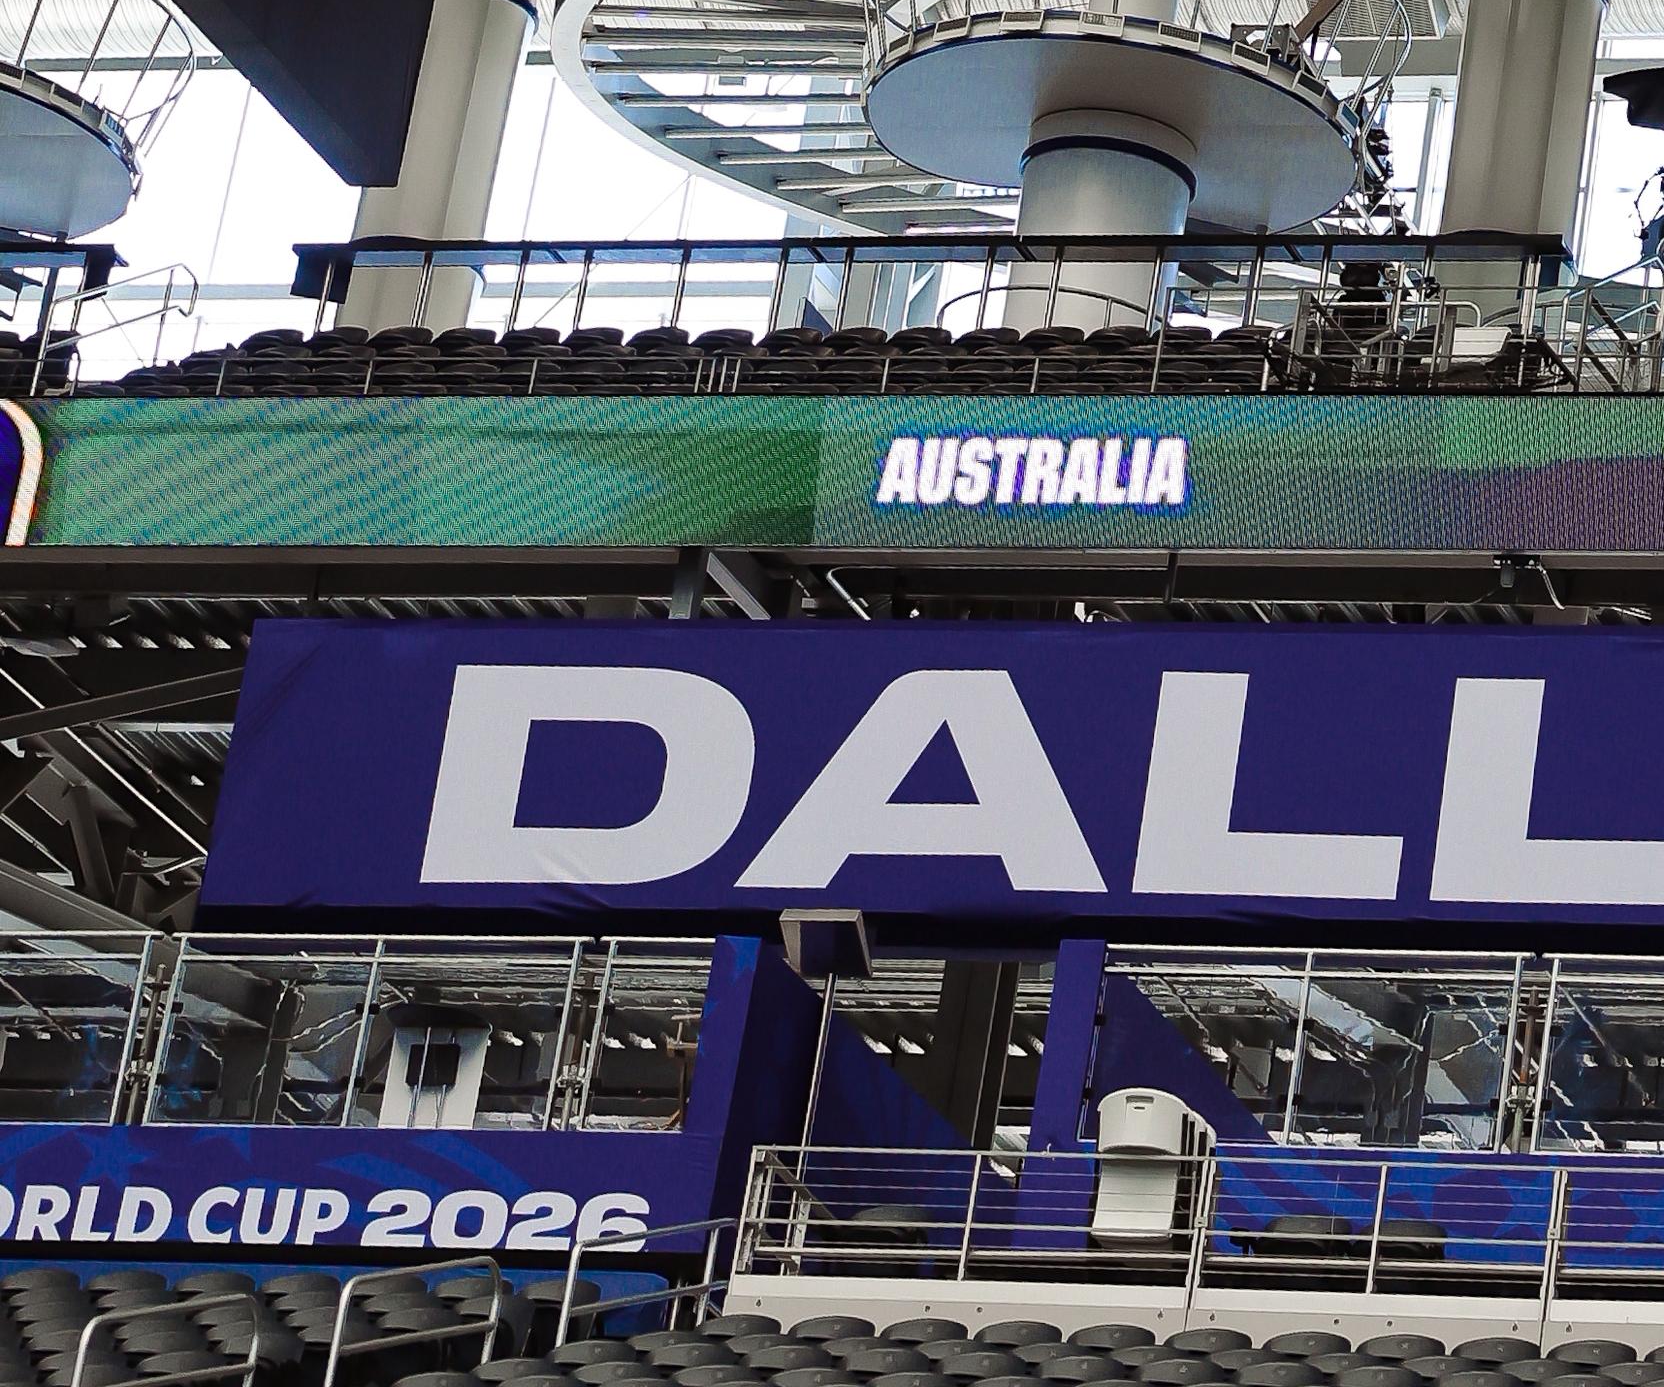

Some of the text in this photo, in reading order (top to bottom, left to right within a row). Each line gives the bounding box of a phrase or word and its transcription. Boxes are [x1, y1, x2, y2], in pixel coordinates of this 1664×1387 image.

[876, 436, 1187, 505] AUSTRALIA
[0, 1184, 650, 1253] RLD CUP 2026
